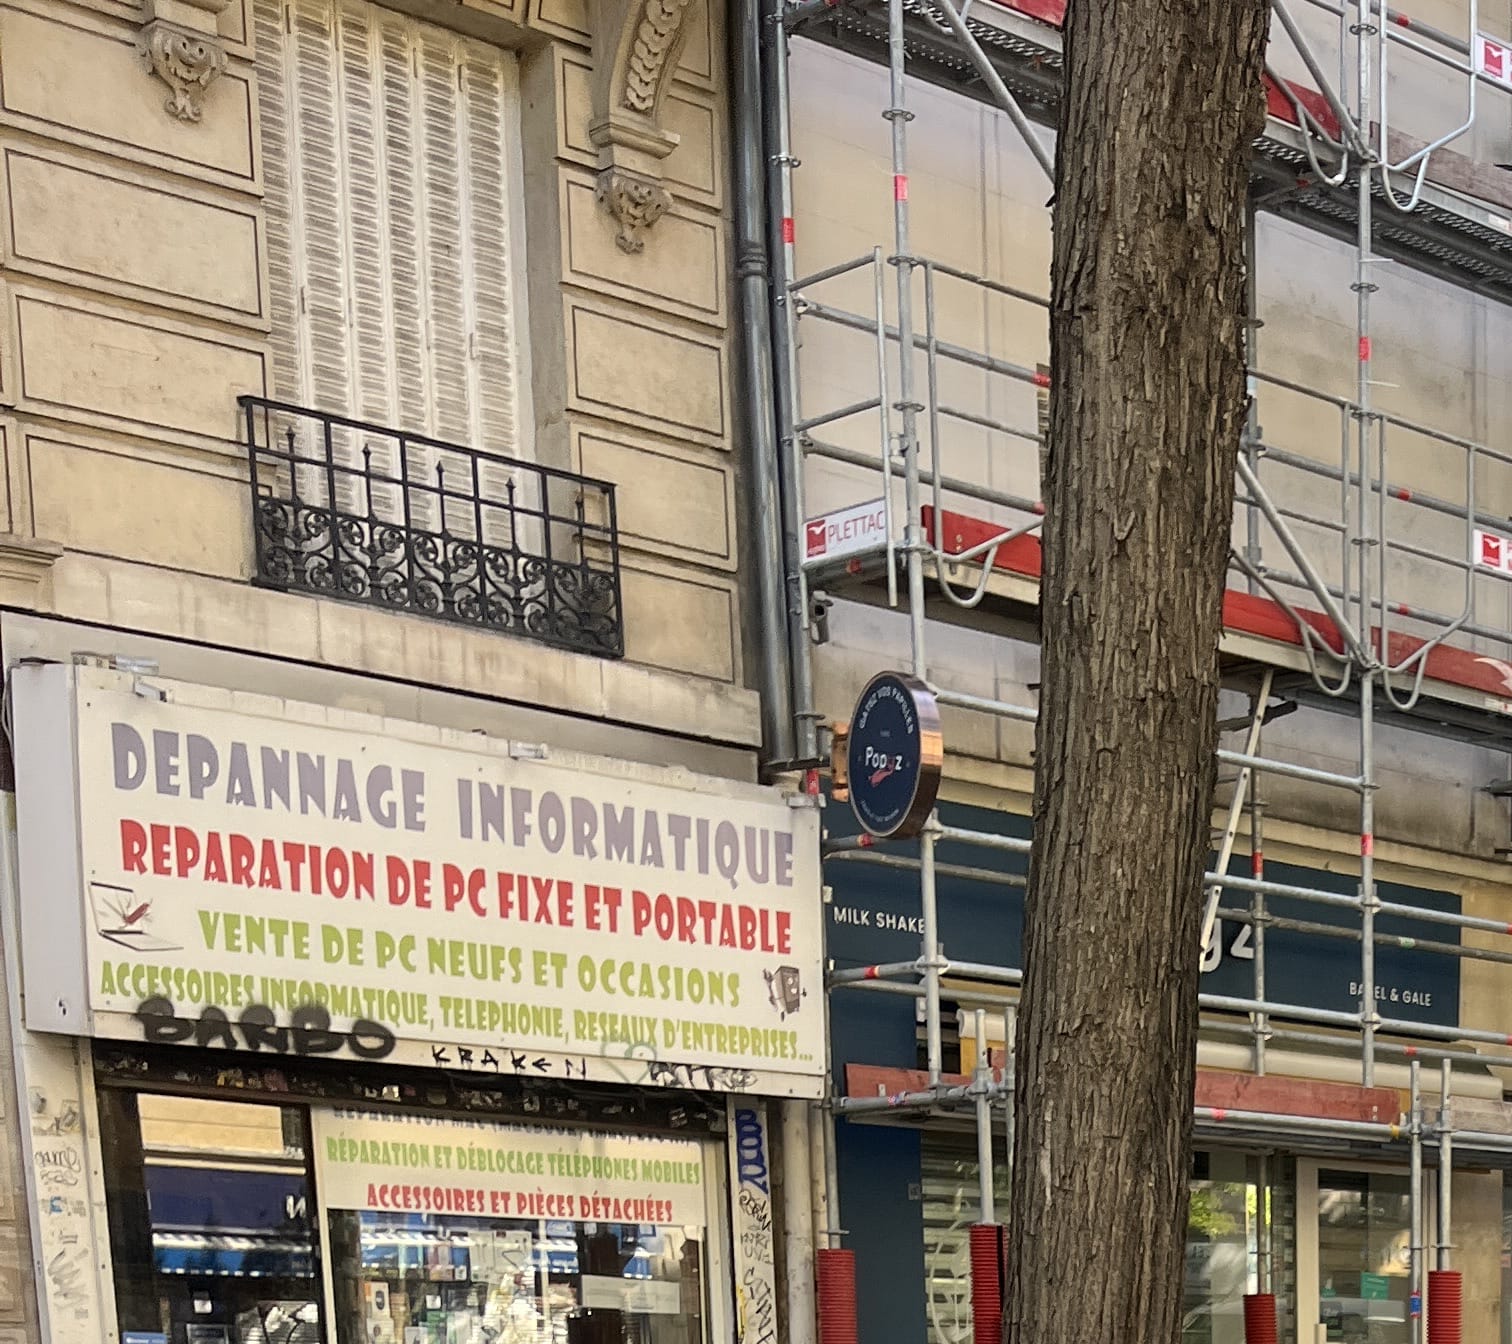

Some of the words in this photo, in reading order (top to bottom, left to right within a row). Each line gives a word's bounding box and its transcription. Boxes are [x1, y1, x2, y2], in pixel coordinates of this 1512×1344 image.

[828, 511, 885, 543] PLETTAC
[111, 722, 426, 833] DEPANNAGE
[457, 778, 793, 889] INFORMATIQUE
[120, 818, 375, 901] REPARATION
[386, 855, 432, 909] DE
[442, 863, 487, 917] PC
[497, 871, 574, 927] FIXE
[584, 883, 622, 934] ET
[632, 889, 792, 955] PORTABLE
[834, 906, 869, 926] MILK
[876, 912, 925, 935] SHAKE
[198, 910, 311, 960] VENTE
[321, 923, 365, 967] DE
[375, 930, 417, 974] PC
[427, 937, 523, 984] NEUFS
[532, 949, 568, 989] ET
[577, 954, 741, 1009] OCCASIONS
[100, 960, 255, 1011] ACCESSOIRES
[261, 977, 434, 1034] INFORMATIQUE,
[440, 995, 570, 1045] TELEPHONIE,
[574, 1009, 658, 1048] RESEAUX
[1350, 981, 1387, 1002] BAEL
[1390, 986, 1399, 1003] &
[1402, 990, 1432, 1007] GALE
[431, 1044, 587, 1081] KRAKEN
[326, 1131, 430, 1168] RÉPARATION
[434, 1145, 451, 1169] ET
[457, 1141, 545, 1176] DÉBLOCAGE
[641, 1158, 700, 1185] MOBILES
[367, 1183, 485, 1213] ACCESSOIRES
[490, 1191, 511, 1214] ET
[516, 1186, 574, 1217] PIÈCES
[579, 1190, 673, 1223] DÉTACHÉES
